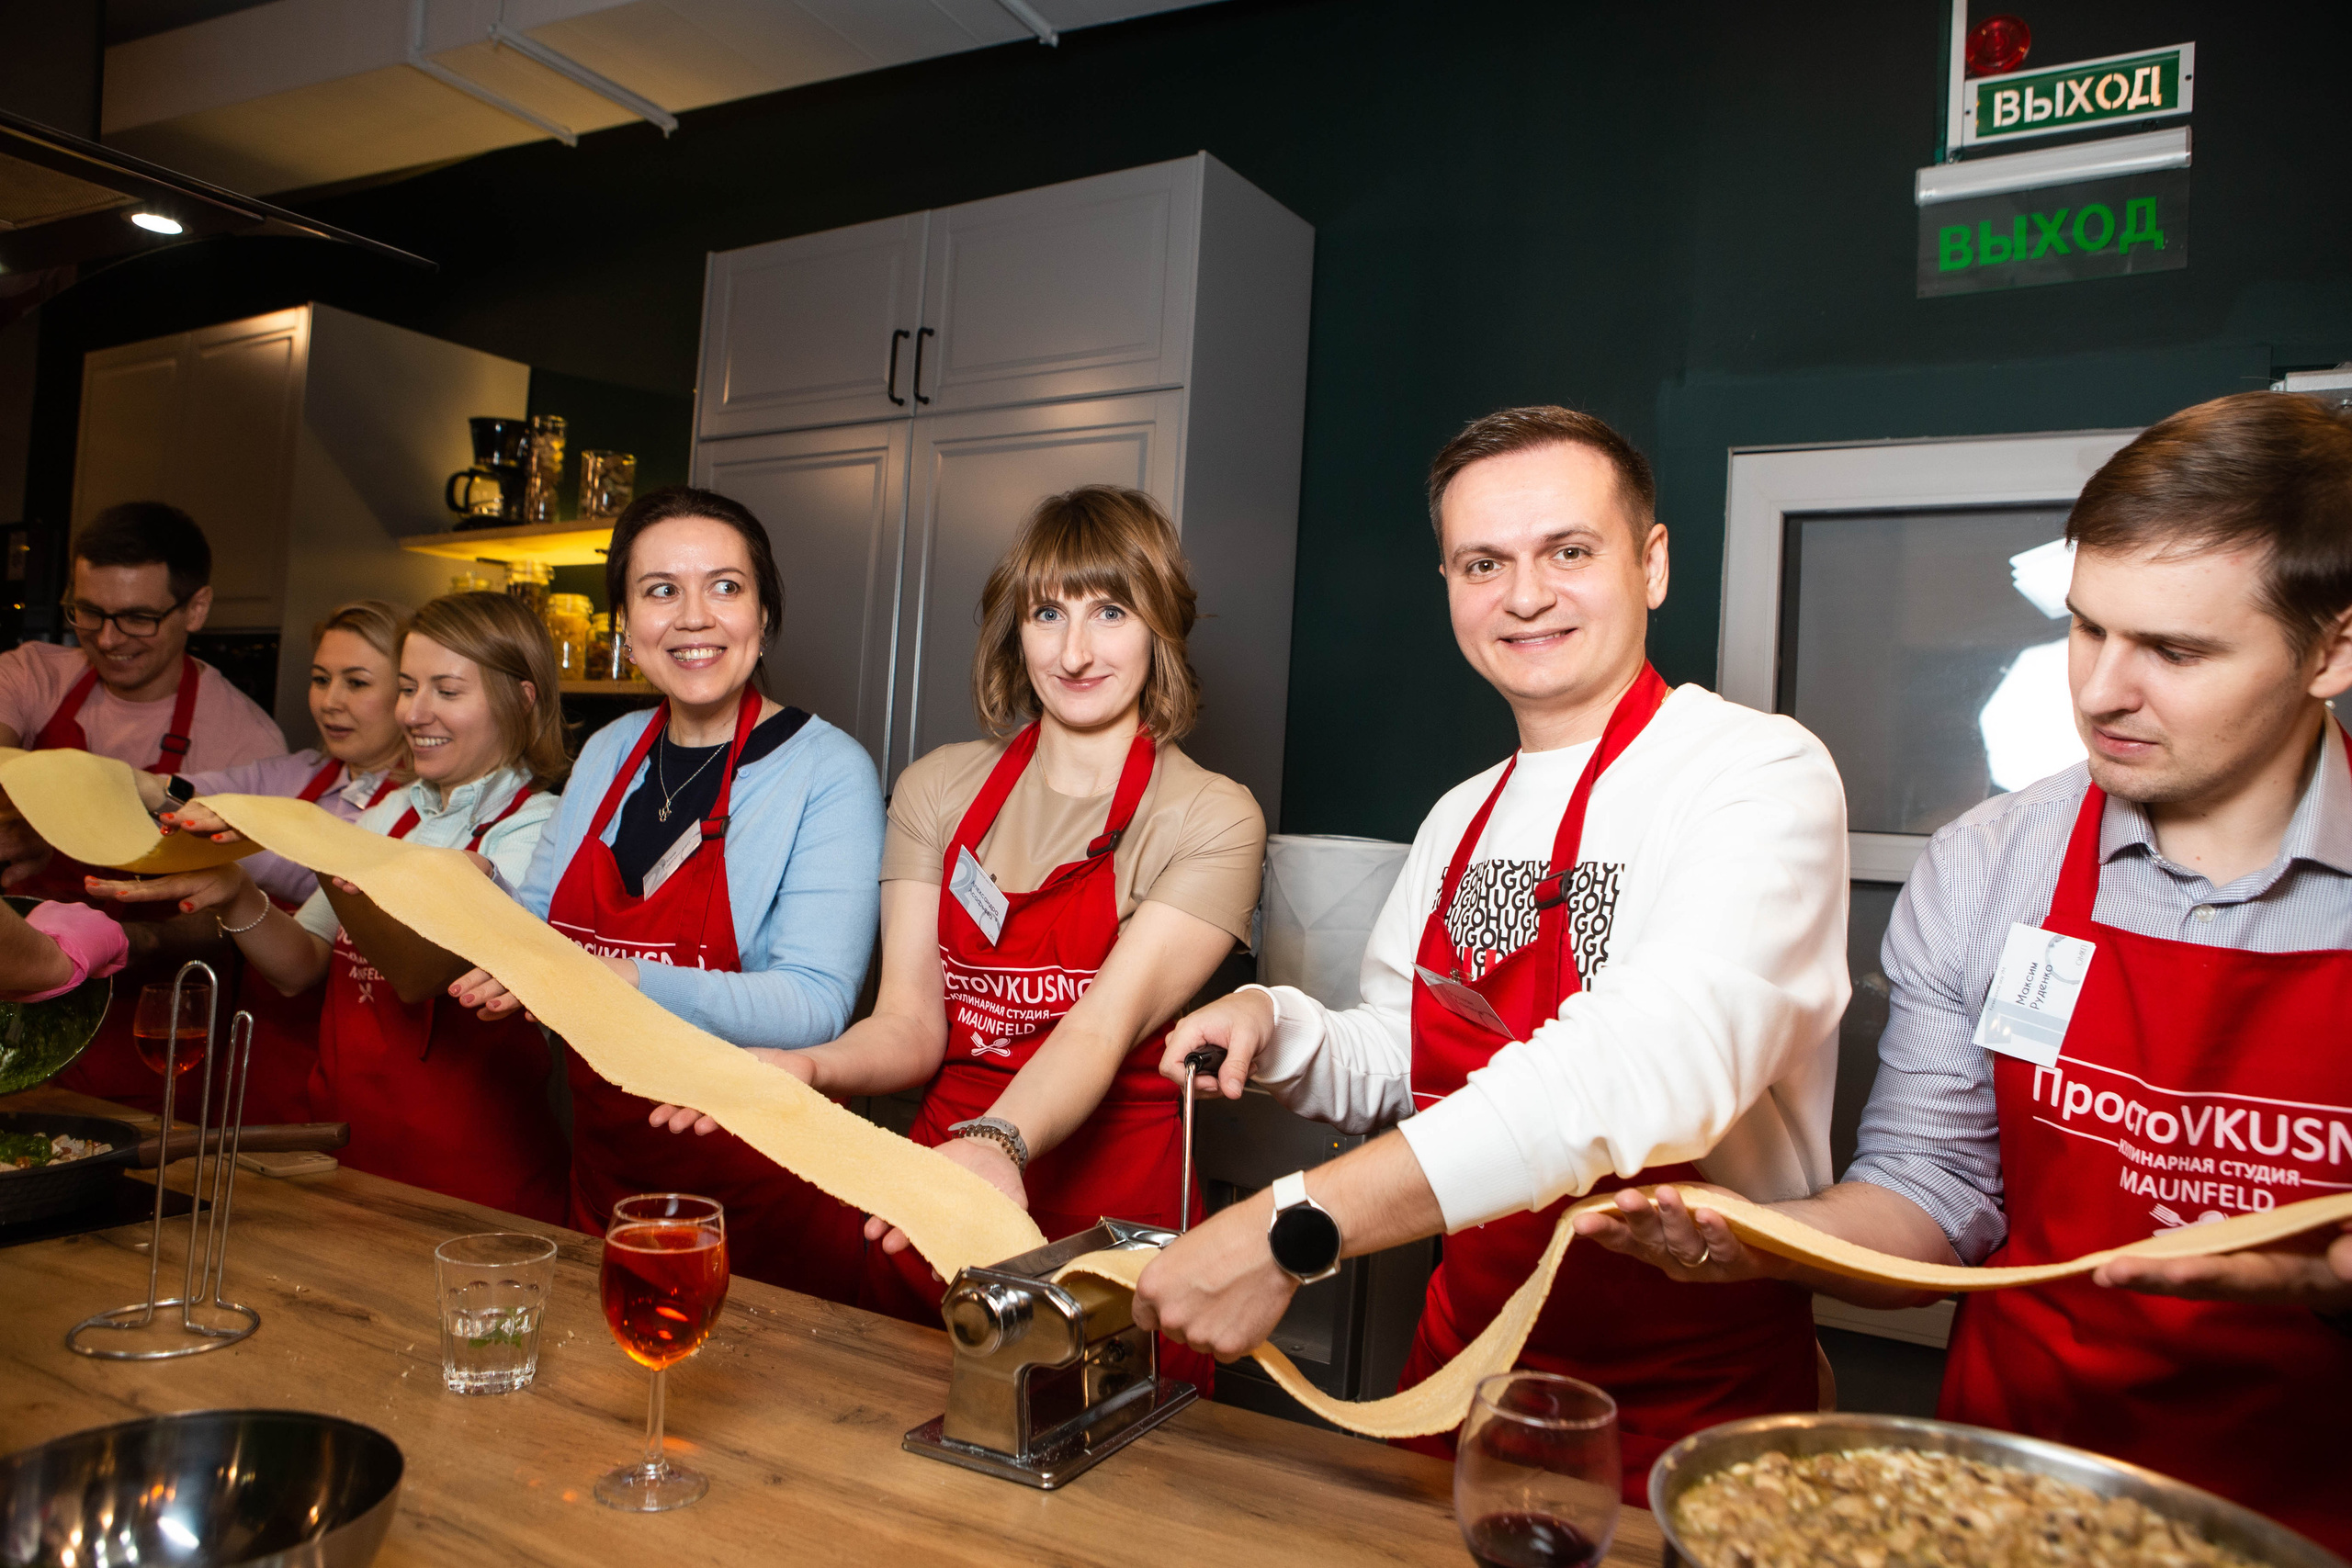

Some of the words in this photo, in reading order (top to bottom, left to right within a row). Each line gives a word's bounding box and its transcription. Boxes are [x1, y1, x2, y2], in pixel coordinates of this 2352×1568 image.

[1993, 66, 2162, 128] ВЫХОД
[1939, 196, 2165, 272] ВЫХОД
[2015, 962, 2039, 1006] Максим
[2030, 964, 2053, 1010] Руденко
[950, 993, 1006, 1017] КУЛИНАРНАЯ
[1006, 1009, 1050, 1021] СТУДИЯ
[957, 1007, 1036, 1036] MAUNFELD
[2120, 1166, 2275, 1213] MAUNFELD
[2219, 1159, 2301, 1187] СТУДИЯ
